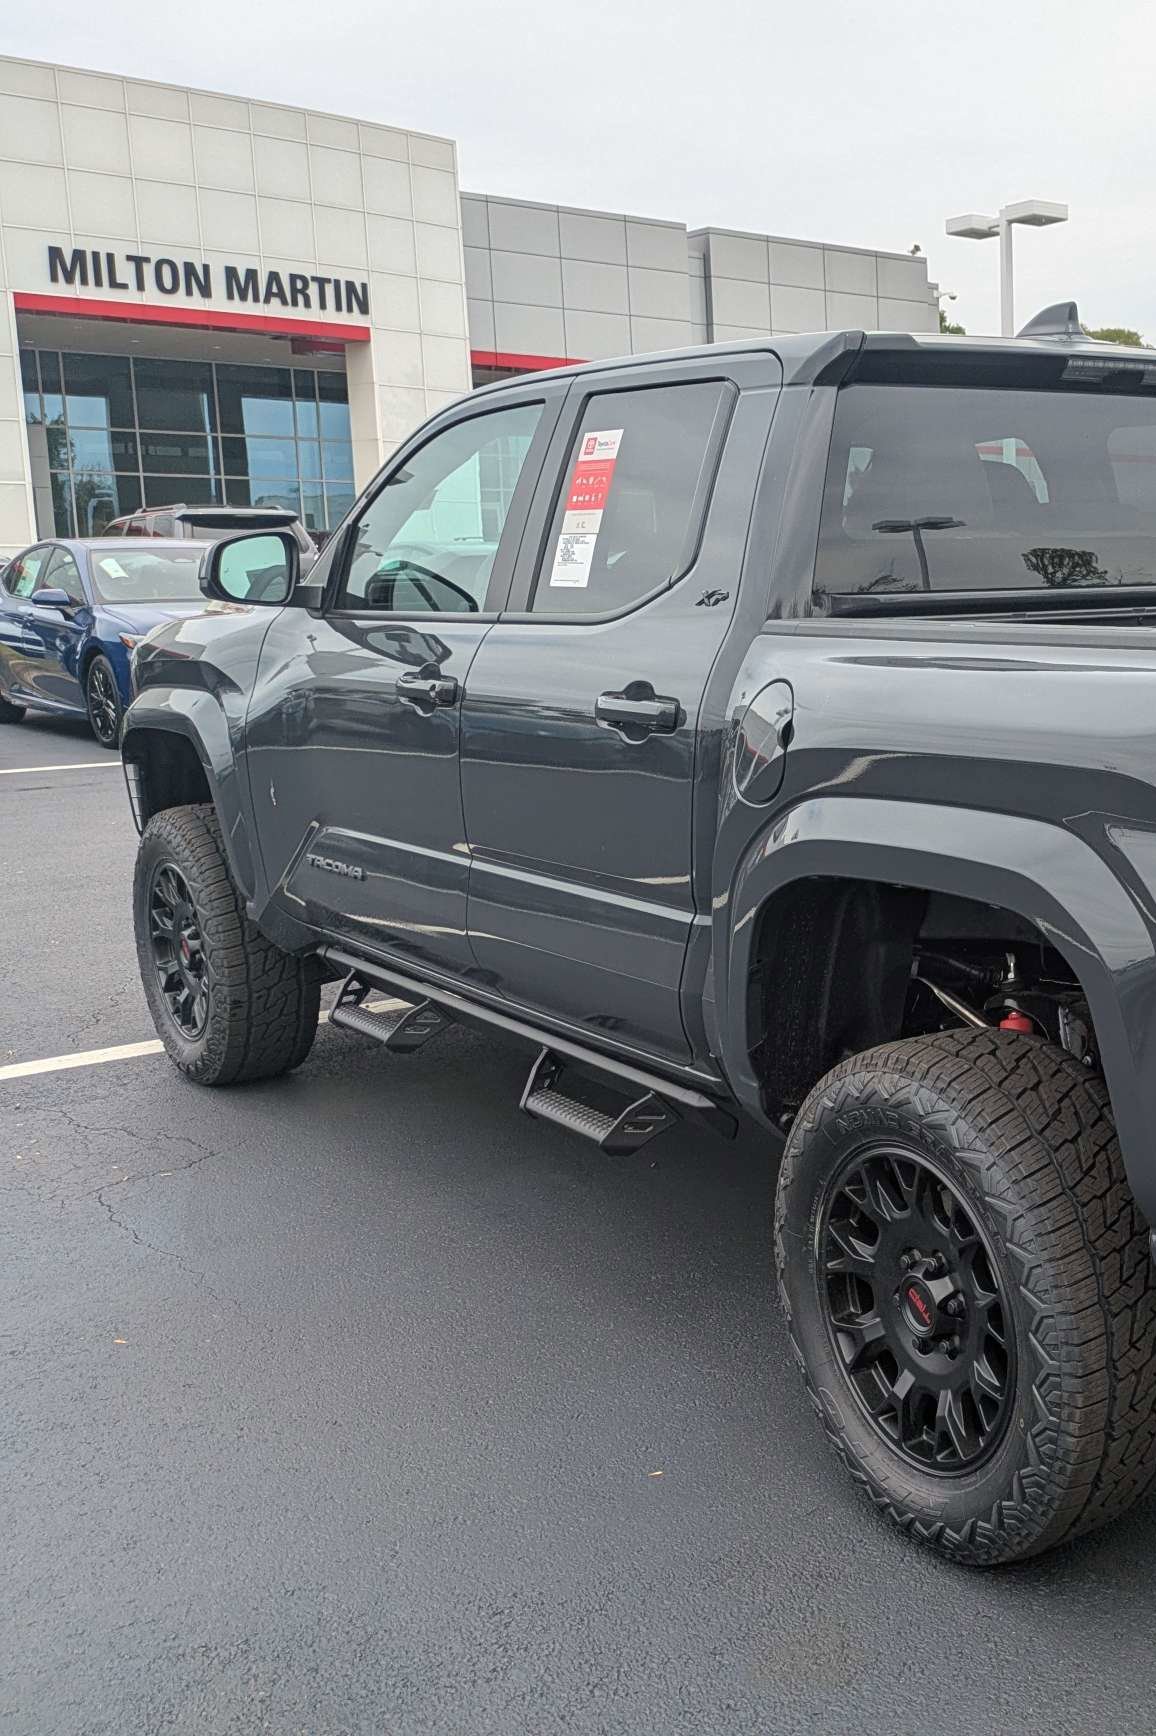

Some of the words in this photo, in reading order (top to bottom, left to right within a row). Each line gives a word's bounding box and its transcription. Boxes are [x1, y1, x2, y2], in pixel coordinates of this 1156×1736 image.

[47, 245, 213, 299] MILTON
[224, 265, 370, 315] MARTIN
[306, 853, 363, 880] TACOMA
